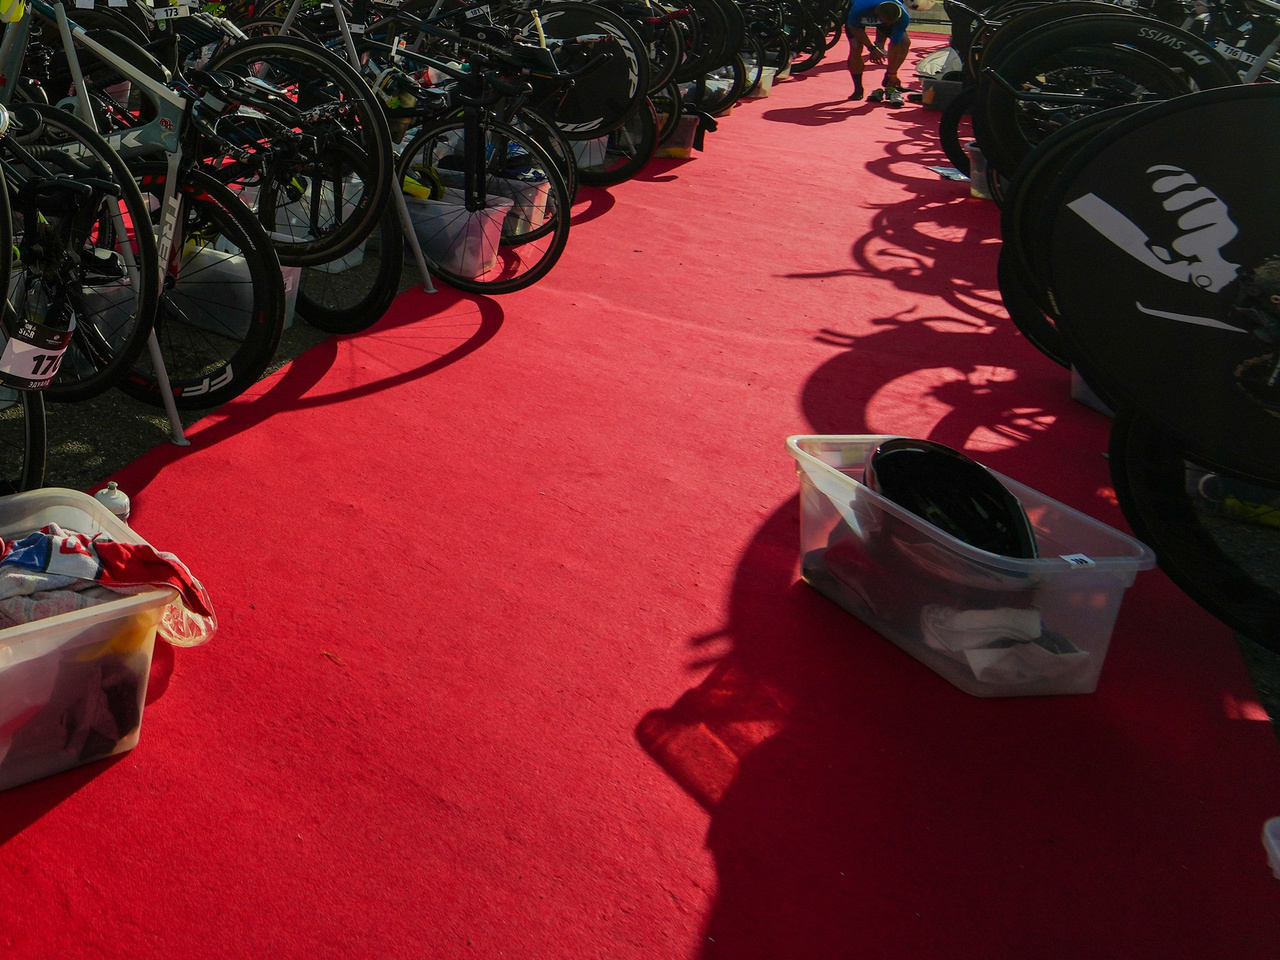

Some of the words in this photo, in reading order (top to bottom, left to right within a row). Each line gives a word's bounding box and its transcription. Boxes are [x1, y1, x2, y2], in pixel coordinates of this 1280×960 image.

[164, 8, 179, 17] 173
[1137, 27, 1187, 50] SWISS
[1183, 49, 1212, 66] DT
[1224, 46, 1239, 57] 116
[18, 327, 36, 340] STAR
